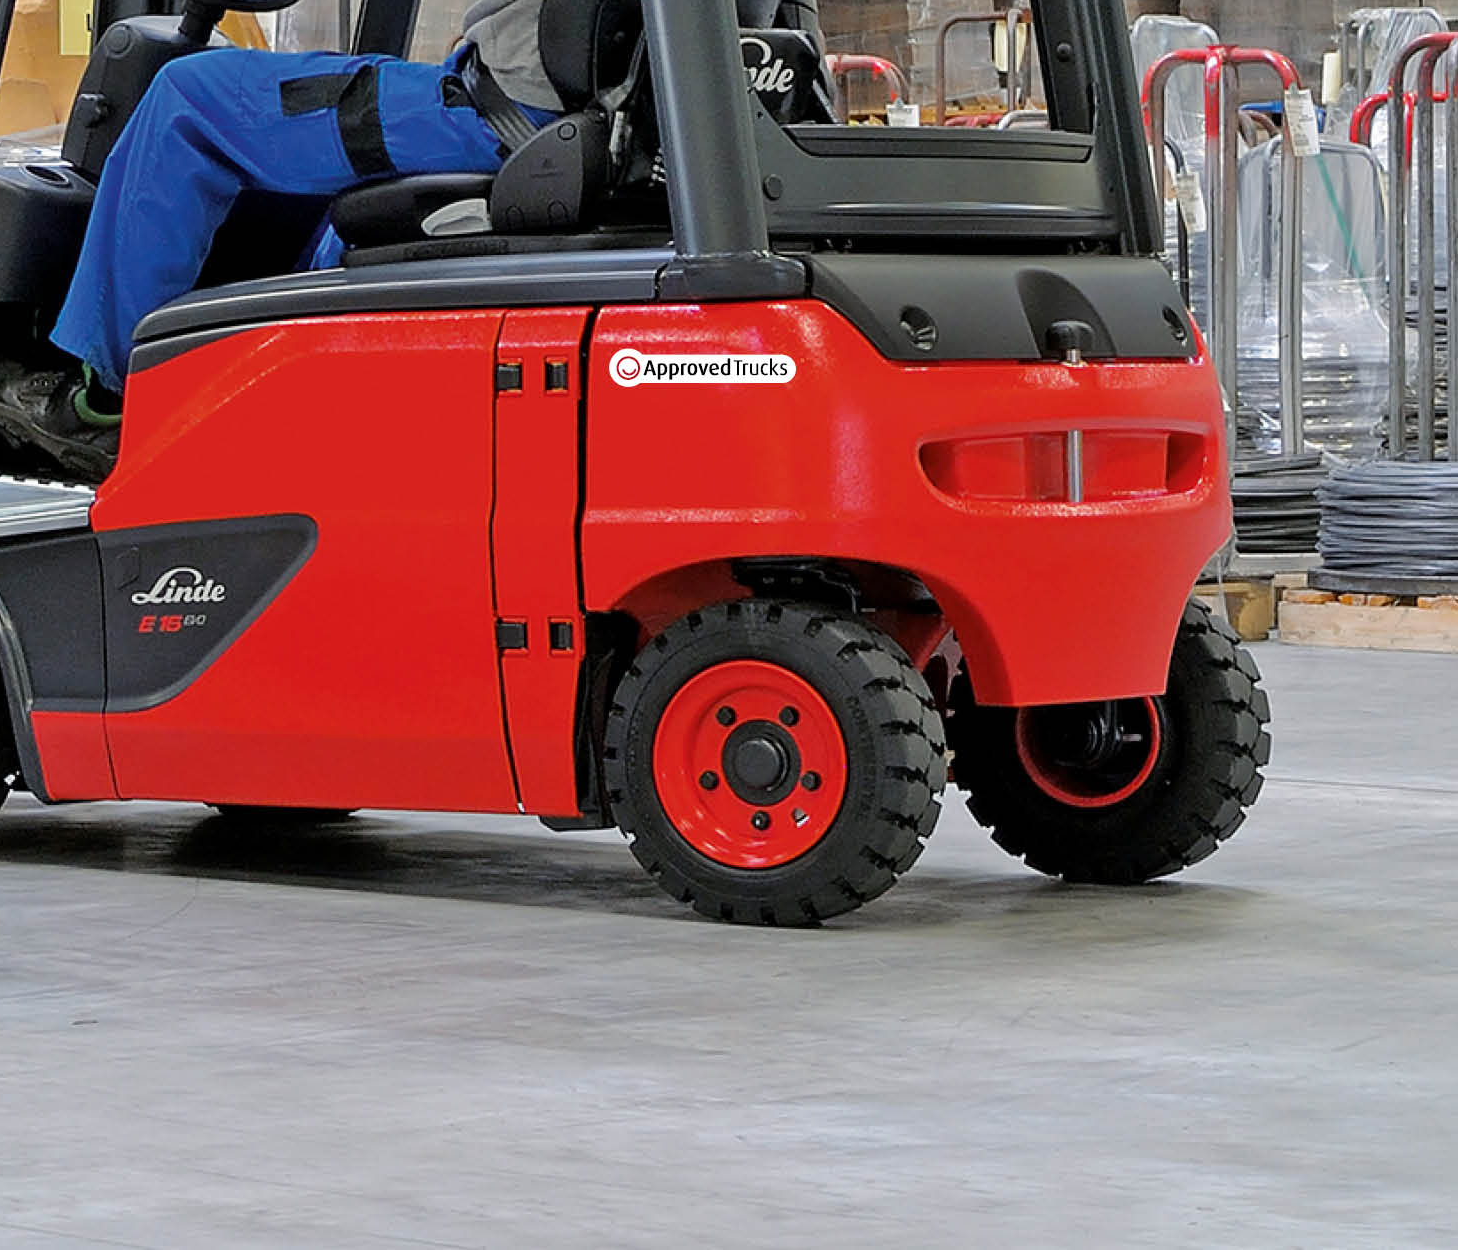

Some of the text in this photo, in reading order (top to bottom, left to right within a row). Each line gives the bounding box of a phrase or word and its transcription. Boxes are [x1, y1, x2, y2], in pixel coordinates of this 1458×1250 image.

[739, 38, 794, 92] nde
[643, 358, 788, 380] Approved Trucks
[131, 566, 226, 604] Linde
[138, 615, 156, 633] E
